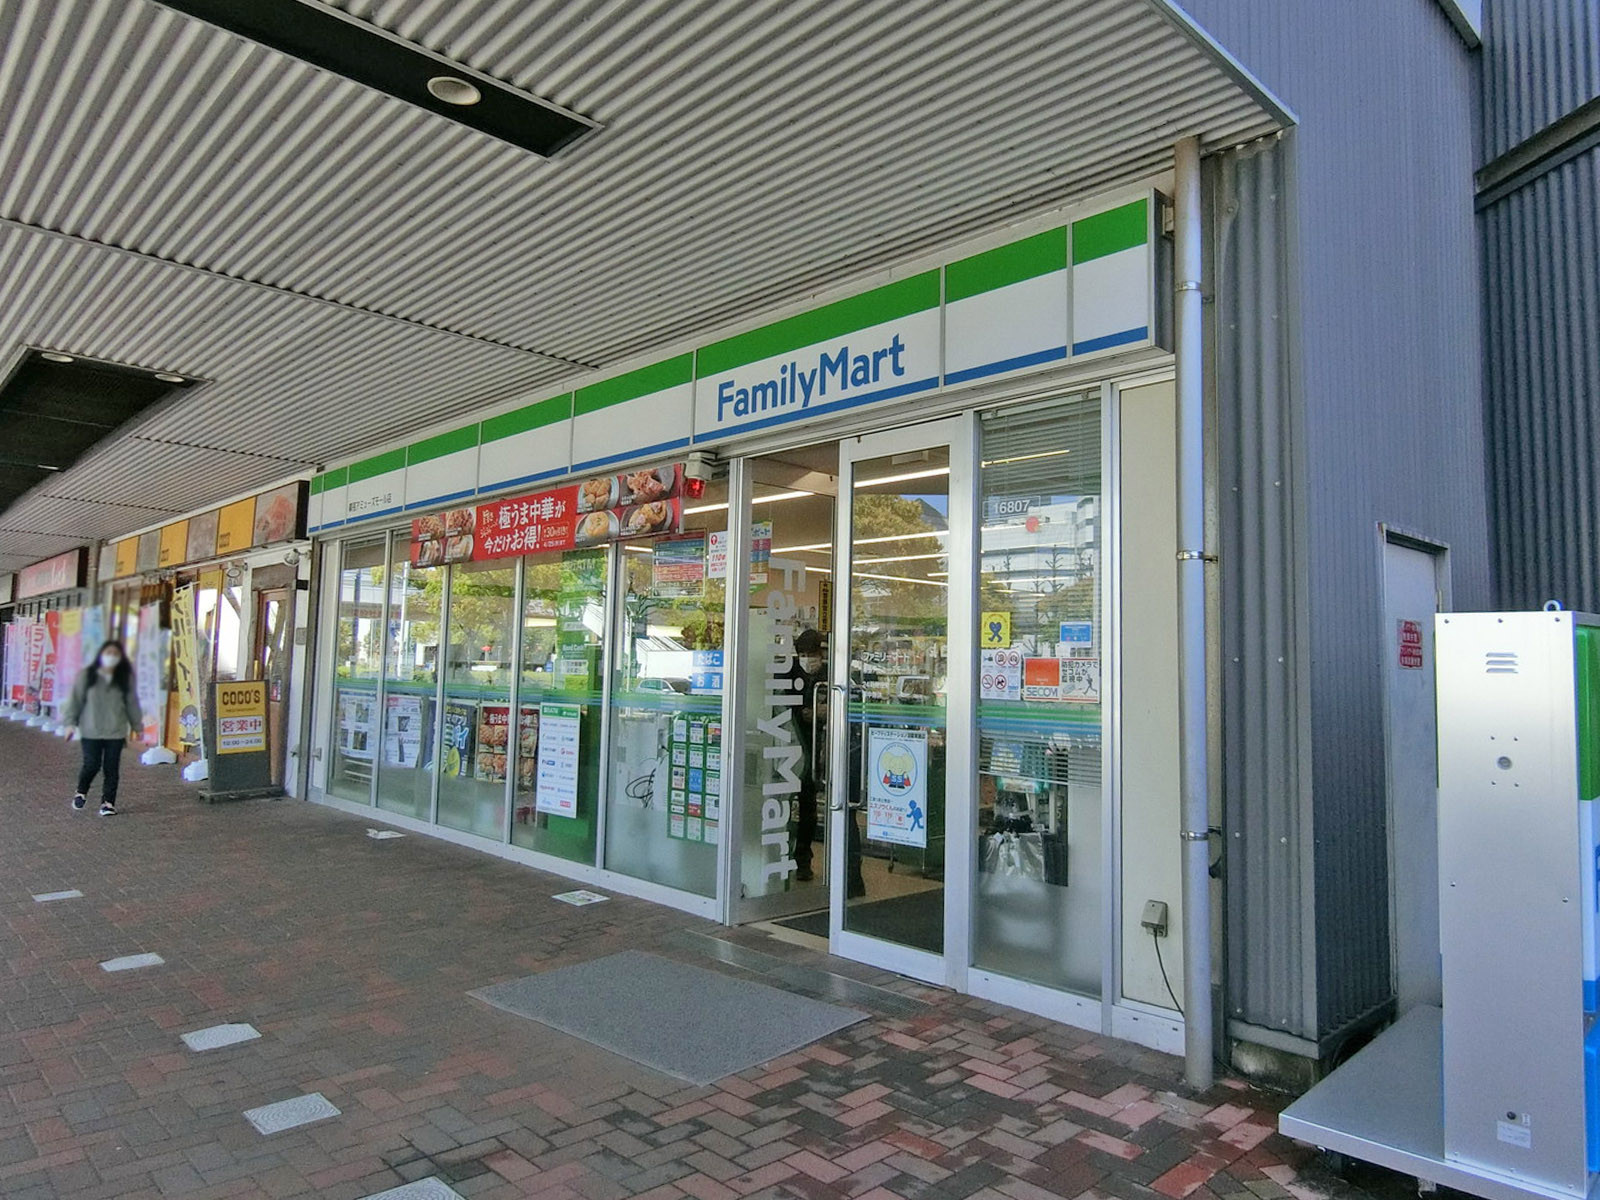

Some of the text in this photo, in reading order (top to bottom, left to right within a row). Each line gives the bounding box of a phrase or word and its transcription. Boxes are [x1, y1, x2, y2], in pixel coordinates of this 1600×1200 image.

[717, 333, 905, 422] FamilyMart
[499, 496, 566, 529] 極うま中華が
[994, 500, 1030, 514] 16807
[484, 524, 541, 554] 今だけお得!
[1061, 661, 1098, 669] 防犯カメラで
[222, 689, 261, 705] COCO'S
[1026, 687, 1058, 697] SECOM
[221, 718, 261, 733] 営業中
[757, 557, 806, 880] FamilyMart
